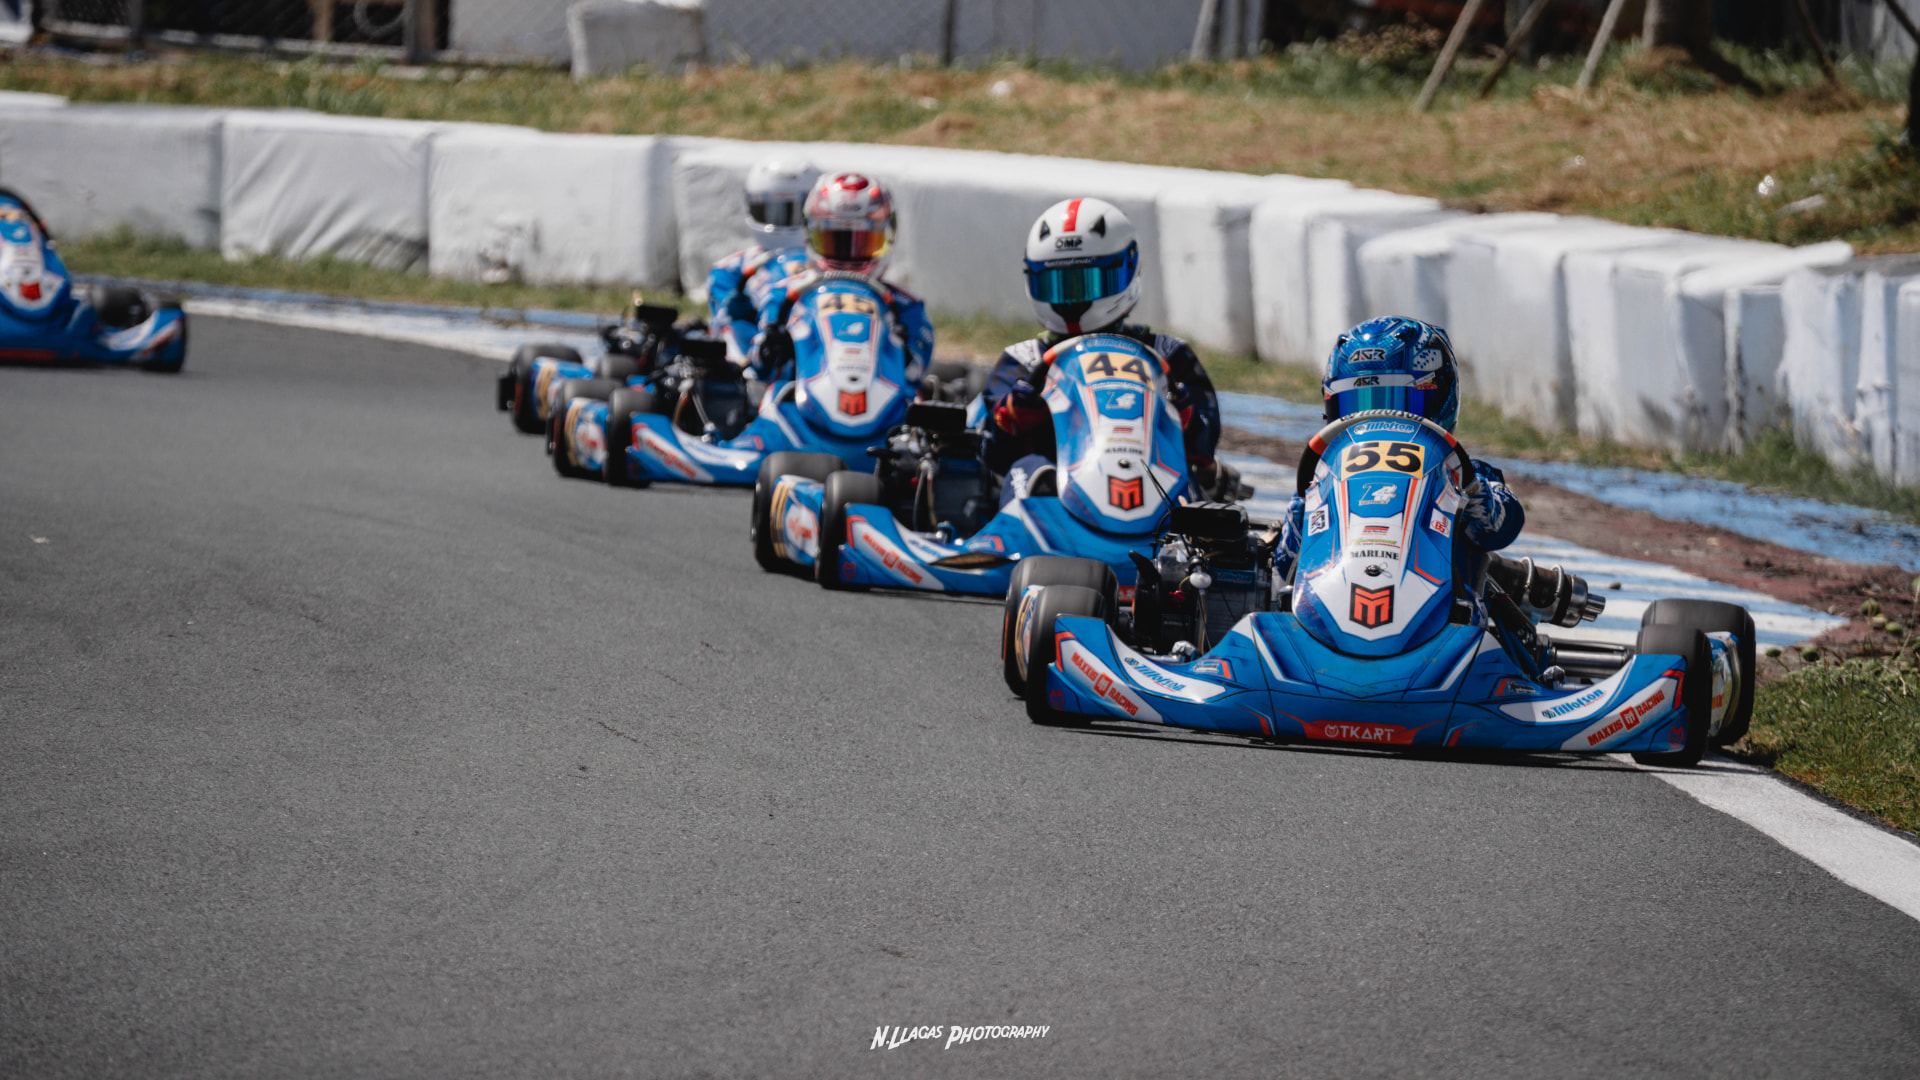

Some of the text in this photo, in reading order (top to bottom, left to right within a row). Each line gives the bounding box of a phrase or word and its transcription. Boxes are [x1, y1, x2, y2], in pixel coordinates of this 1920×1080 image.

[1055, 237, 1082, 250] OMP
[1087, 353, 1151, 385] 44
[1366, 421, 1415, 433] Tillotson
[1345, 441, 1421, 472] 55
[1351, 550, 1399, 560] MARLINE
[1071, 652, 1139, 716] MAXXIS RACING
[1135, 664, 1187, 691] Tillotson
[1552, 689, 1604, 716] Tillotson
[1587, 719, 1623, 746] MAXXIS
[1636, 690, 1665, 717] RACING
